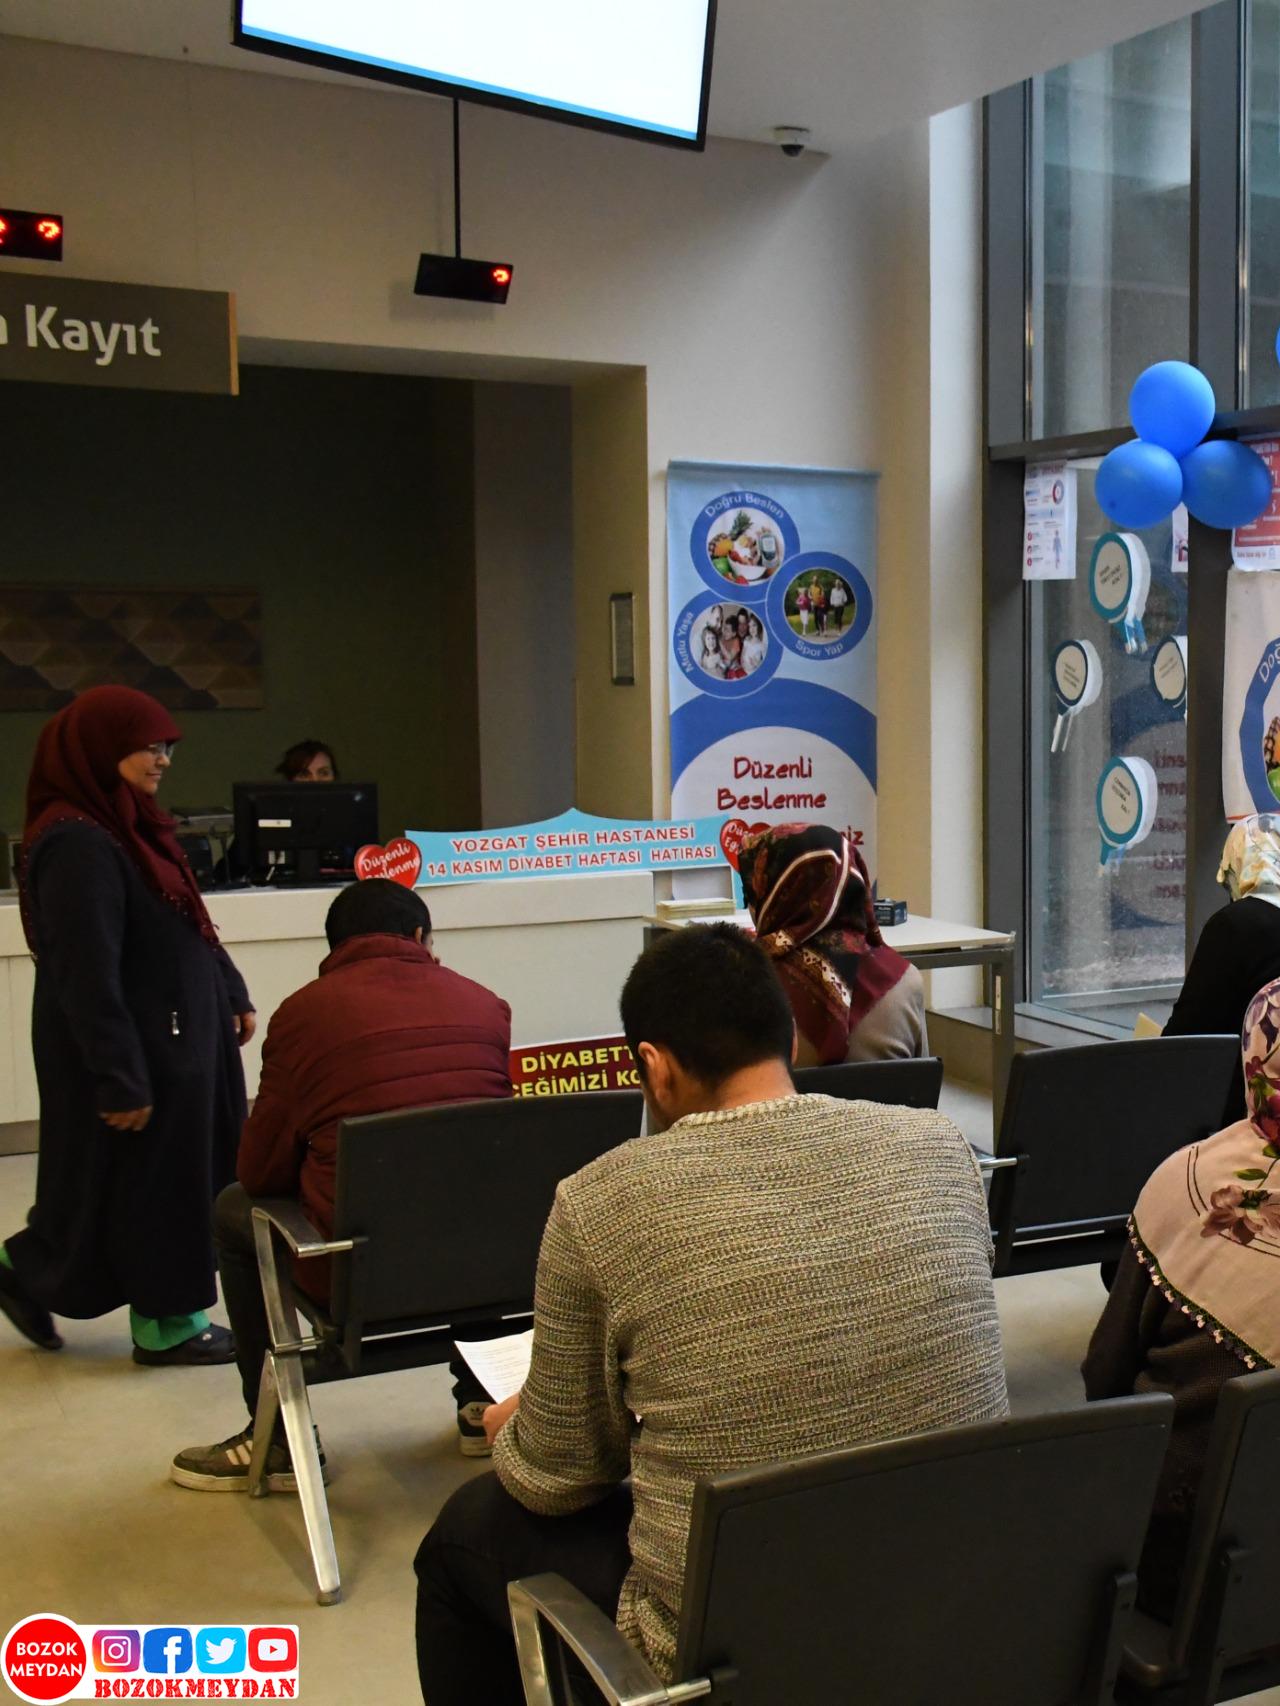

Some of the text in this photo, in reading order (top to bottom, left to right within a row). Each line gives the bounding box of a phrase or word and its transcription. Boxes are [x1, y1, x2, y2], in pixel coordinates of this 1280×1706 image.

[25, 304, 162, 366] Kayıt
[704, 493, 785, 519] Doğru Beslen
[677, 639, 693, 673] Mutlu
[795, 640, 844, 657] Spor Yap
[733, 756, 813, 779] Düzenli
[717, 787, 827, 811] Beslenme
[453, 823, 694, 852] YOZGAT ŞEHİR HASTANESİ
[362, 843, 411, 872] Düzenli
[428, 863, 446, 876] 14
[453, 859, 502, 874] KASIM
[509, 854, 573, 872] DİYABET
[578, 851, 641, 866] HAFTASI
[651, 846, 717, 861] HATIRASI
